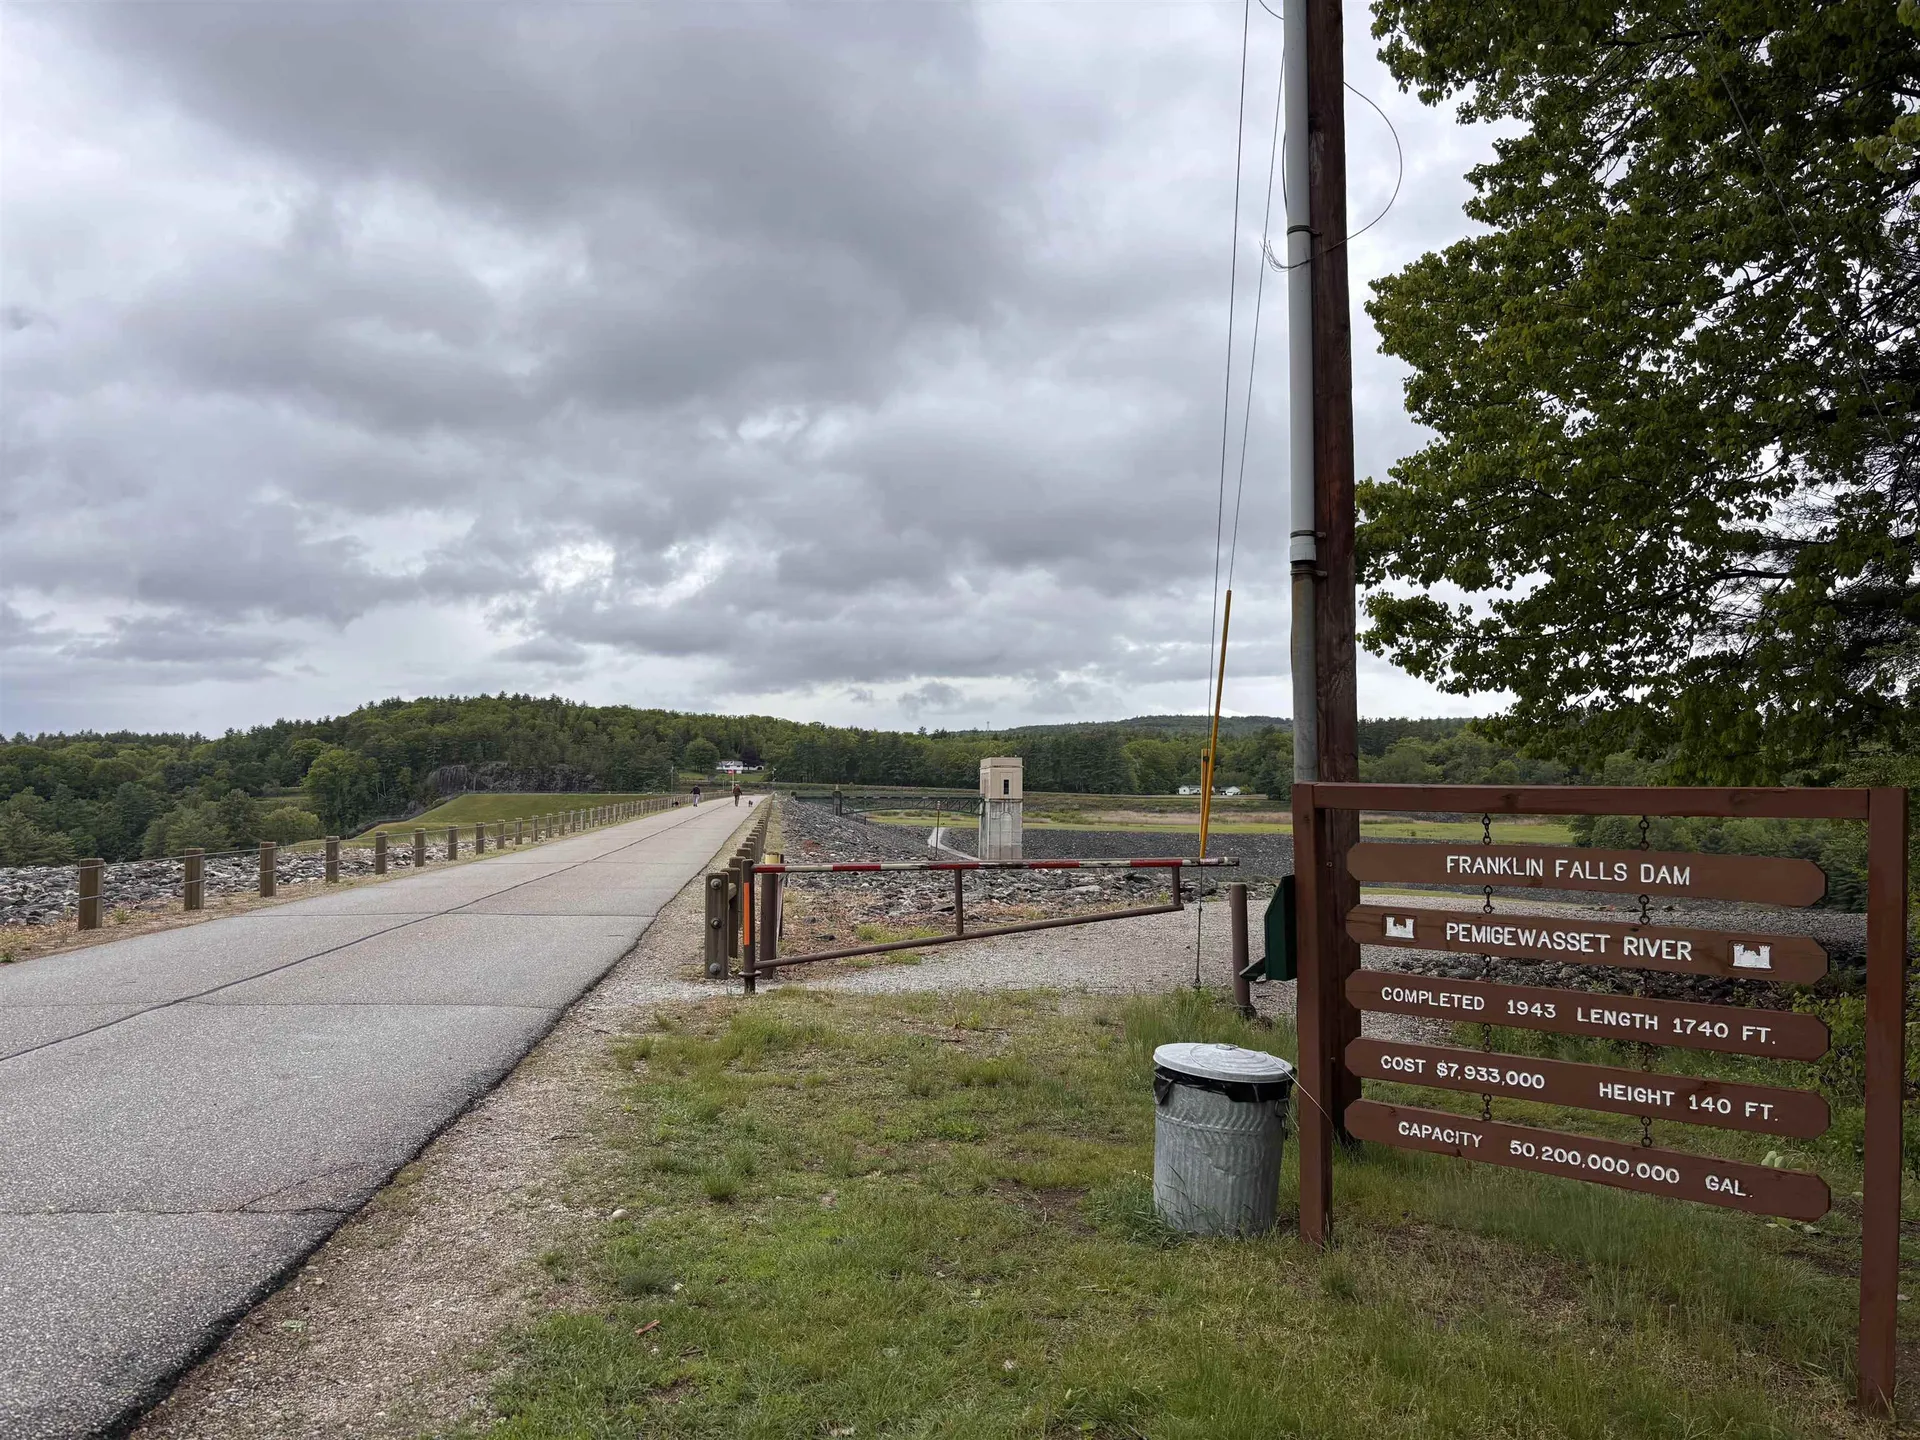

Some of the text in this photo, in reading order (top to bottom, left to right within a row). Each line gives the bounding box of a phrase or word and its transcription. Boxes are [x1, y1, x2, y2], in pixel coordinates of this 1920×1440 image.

[1446, 855, 1690, 886] FRANKLIN FALLS DAM
[1445, 922, 1692, 962] PEMIGEWASSET RIVER
[1381, 986, 1777, 1045] COMPLETED 1943 LENGTH 1740 FT.
[1380, 1055, 1780, 1121] COST $7,933,000 HEIGHT 140 FT.
[1398, 1121, 1483, 1148] CAPACITY
[1705, 1175, 1754, 1198] GAL.
